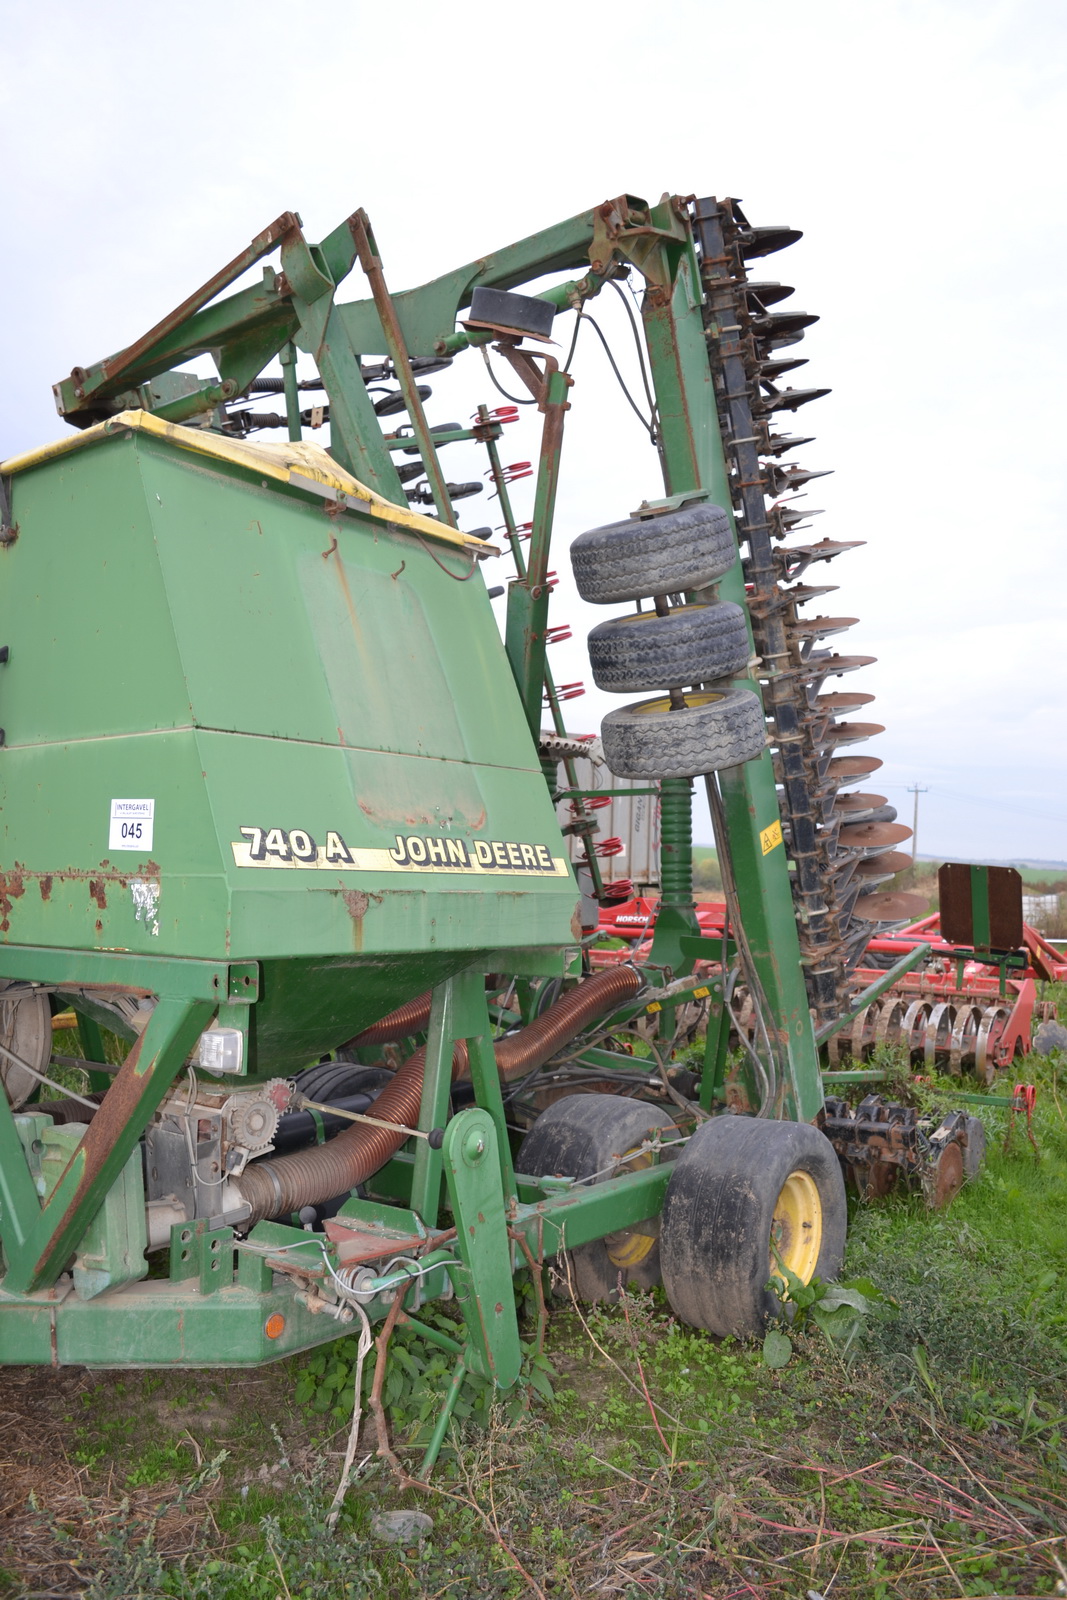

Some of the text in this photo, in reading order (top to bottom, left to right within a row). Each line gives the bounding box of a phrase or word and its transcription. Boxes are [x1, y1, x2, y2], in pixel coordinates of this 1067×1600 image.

[116, 803, 149, 811] INTERGAVEL
[635, 797, 643, 832] GIGAN
[121, 822, 142, 839] 045
[240, 826, 555, 871] 740 A JOHN DEERE
[616, 915, 649, 923] HORSCH
